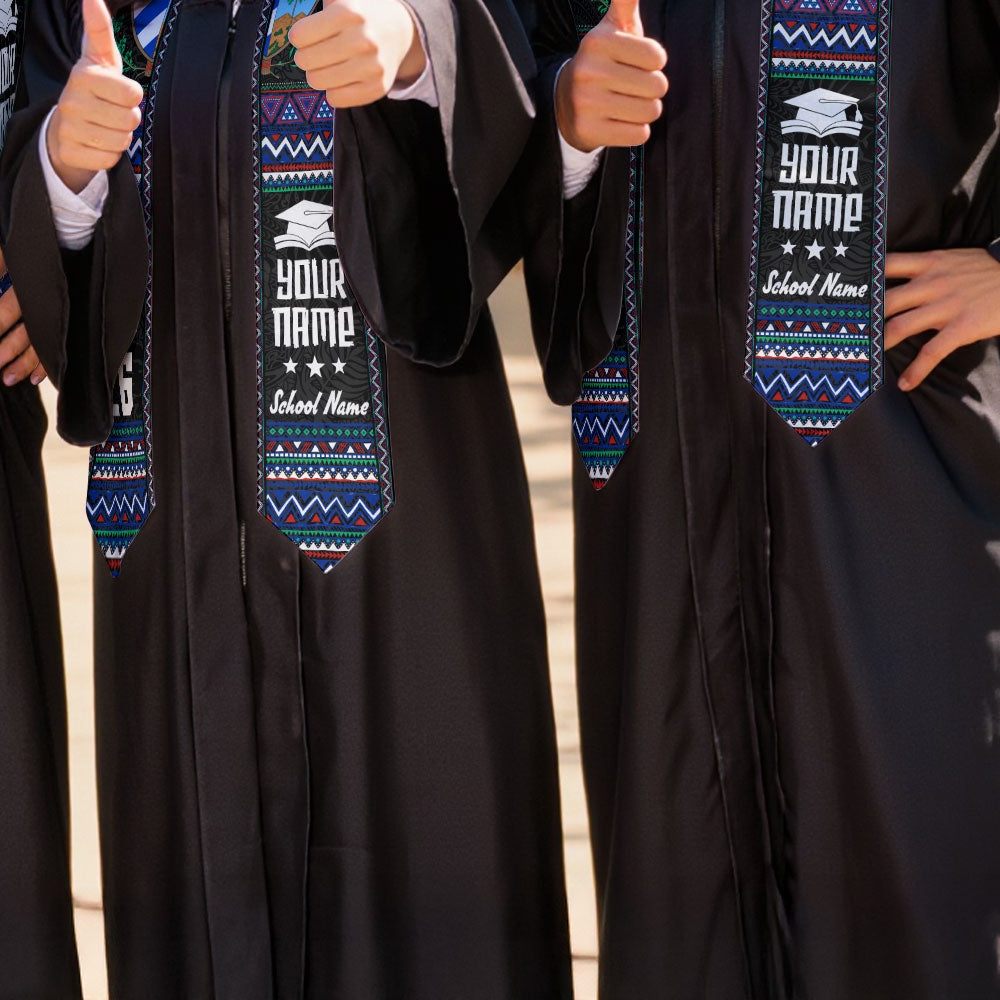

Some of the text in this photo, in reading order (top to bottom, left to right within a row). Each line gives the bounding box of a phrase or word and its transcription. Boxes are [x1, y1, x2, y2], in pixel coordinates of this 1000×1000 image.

[779, 143, 859, 186] YOUR
[772, 190, 864, 232] NAME
[277, 258, 348, 300] YOUR
[762, 269, 869, 298] School Name
[272, 306, 356, 349] NAME
[113, 352, 134, 417] 6
[269, 388, 370, 416] School Name
